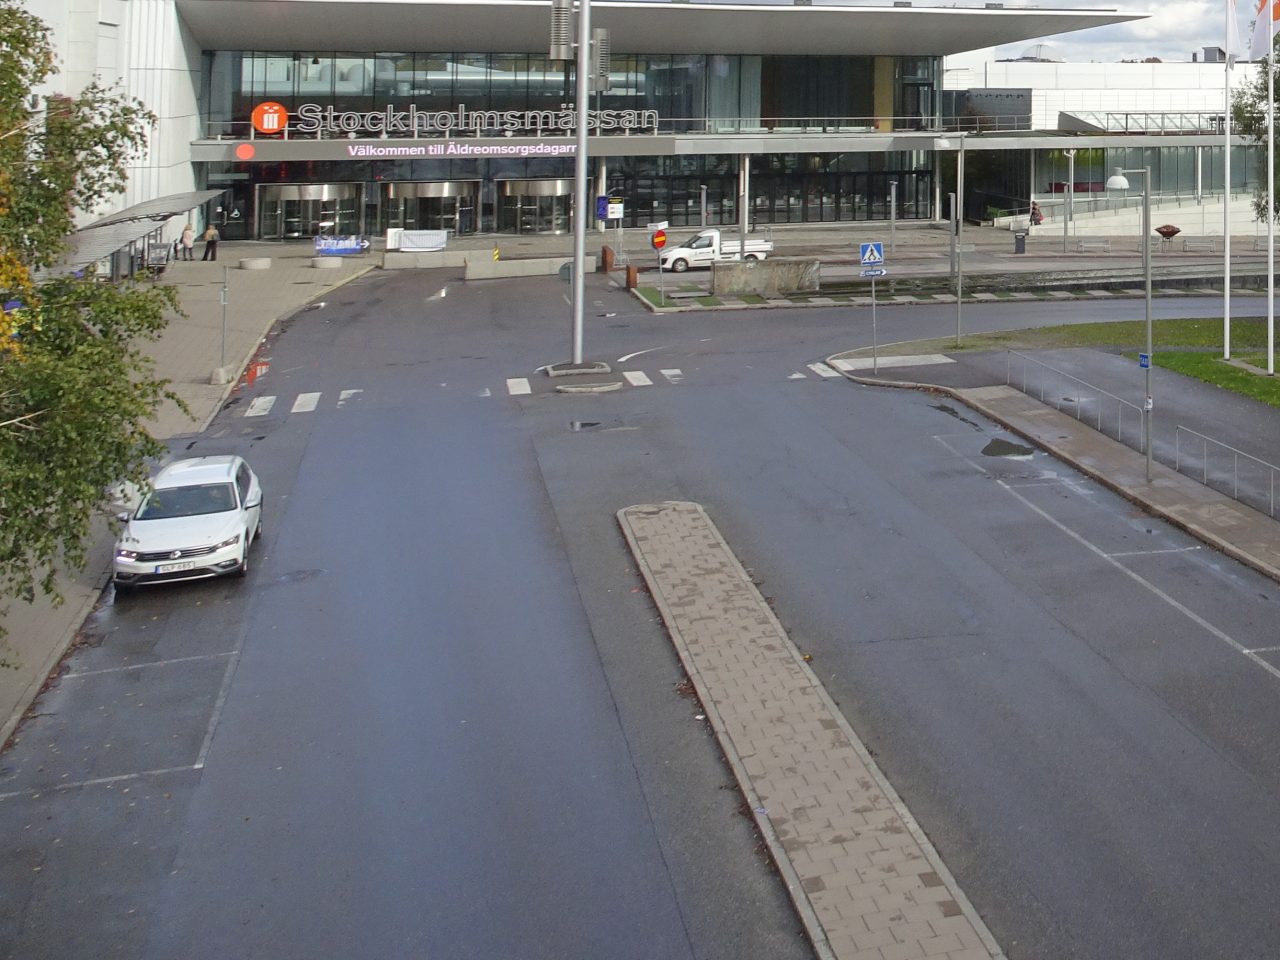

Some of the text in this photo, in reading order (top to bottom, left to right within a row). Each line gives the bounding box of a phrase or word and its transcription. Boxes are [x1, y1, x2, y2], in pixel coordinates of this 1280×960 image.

[297, 103, 659, 131] Stockholmsmässan
[348, 144, 425, 156] Välkommen
[428, 144, 444, 155] till
